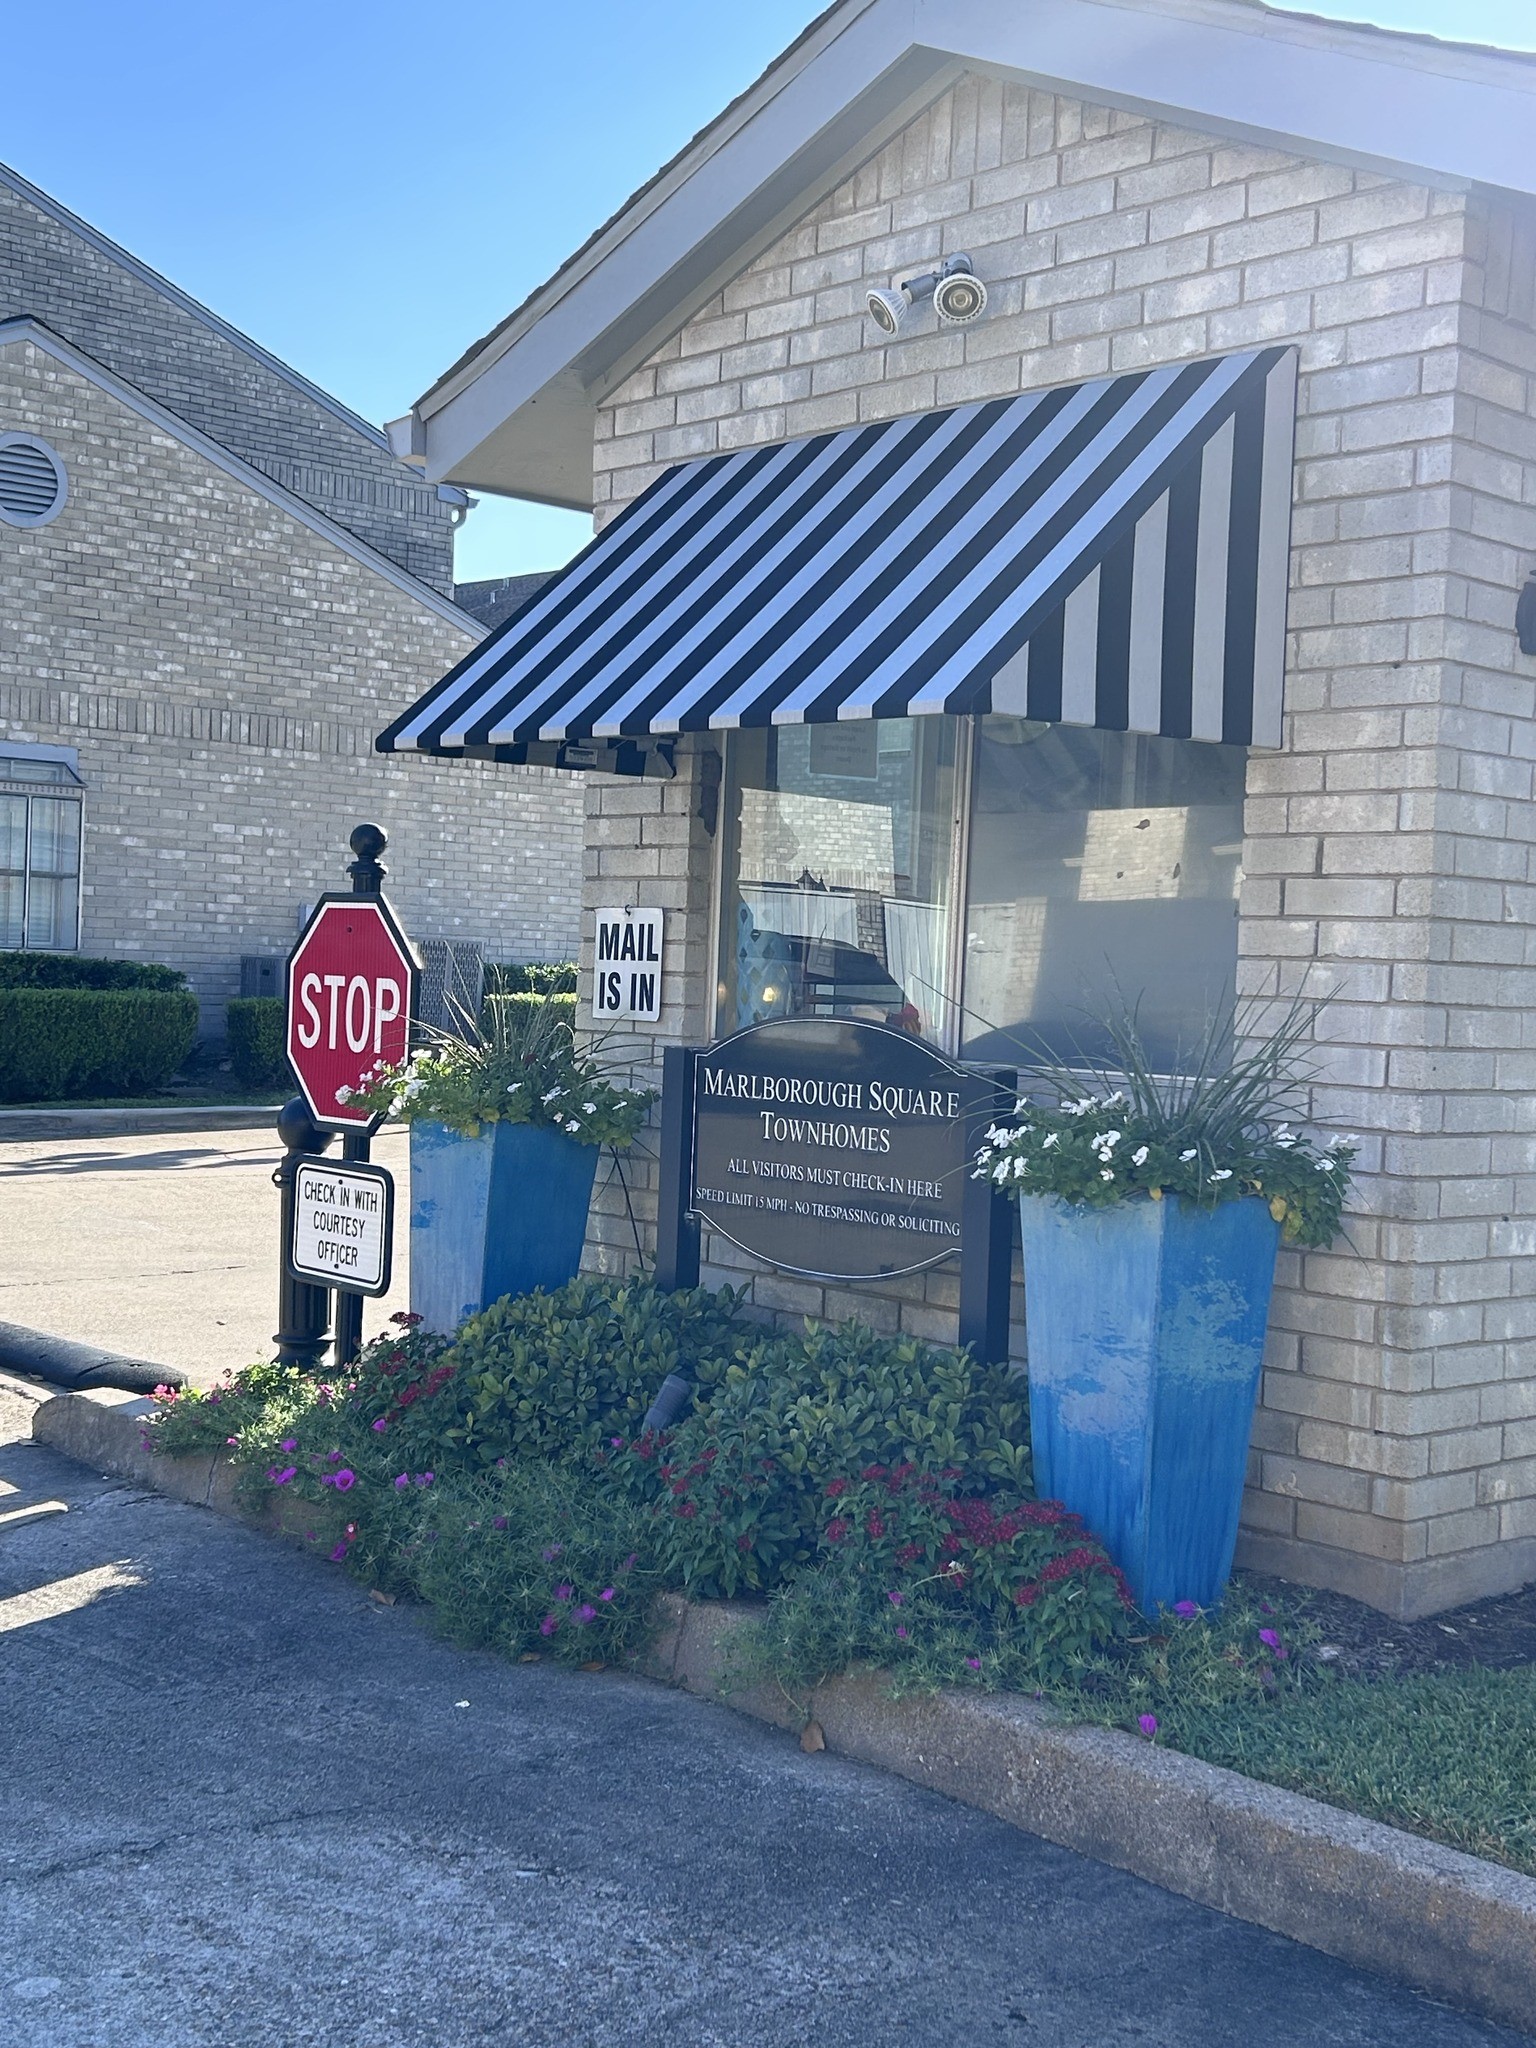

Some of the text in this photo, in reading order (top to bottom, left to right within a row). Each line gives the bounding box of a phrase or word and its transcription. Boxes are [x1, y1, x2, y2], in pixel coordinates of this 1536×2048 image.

[599, 922, 659, 962] MAIL
[599, 971, 655, 1012] IS IN
[297, 972, 400, 1054] STOP
[704, 1067, 960, 1119] MARLBOROUGH SQUARE
[760, 1111, 891, 1153] TOWNHOMES
[304, 1180, 378, 1213] CHECK IN WITH
[727, 1158, 943, 1199] ALL VISITORS MUST CHECK-IN HERE
[313, 1210, 366, 1239] COURTESY
[696, 1187, 724, 1203] SPEED
[726, 1191, 753, 1207] LIMIT
[755, 1196, 764, 1208] 15
[766, 1197, 788, 1212] MPH
[795, 1200, 810, 1215] NO
[812, 1203, 879, 1225] TRESPASSING
[881, 1213, 896, 1227] OR
[898, 1215, 961, 1237] SOLICITING
[317, 1239, 359, 1267] OFFICER
